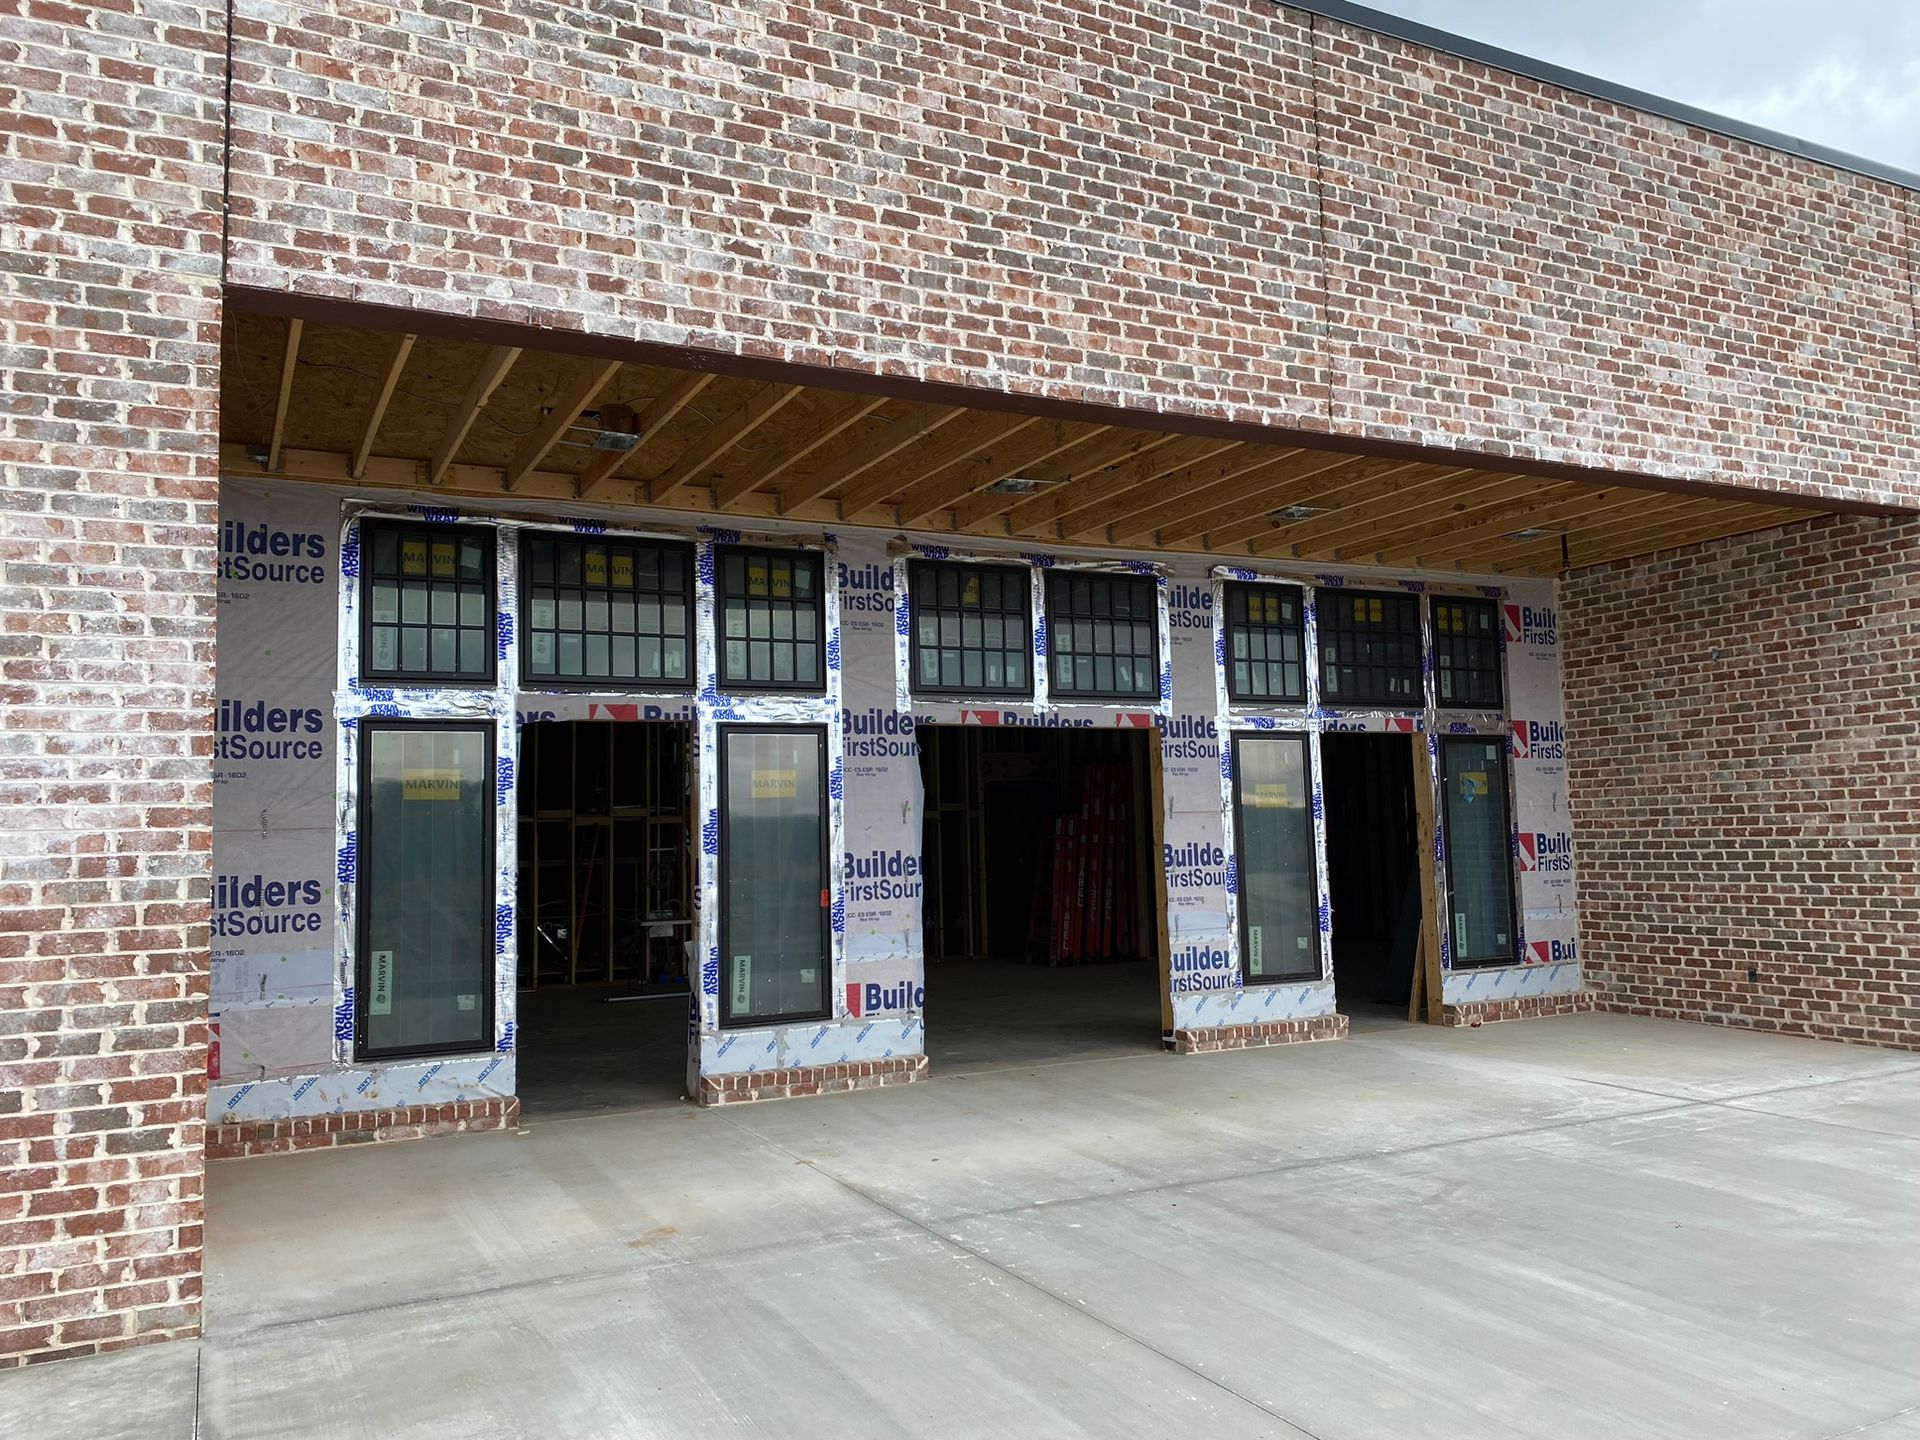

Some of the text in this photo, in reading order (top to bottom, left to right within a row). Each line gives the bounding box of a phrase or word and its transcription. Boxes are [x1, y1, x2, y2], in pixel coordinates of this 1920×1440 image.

[406, 504, 460, 516] WINDOW
[424, 514, 459, 522] WRAP
[558, 516, 607, 529] WINDOW
[218, 521, 325, 558] ilders
[573, 526, 607, 534] WRAP
[697, 525, 741, 537] WINDOW
[713, 535, 741, 544] WRAP
[341, 543, 351, 578] WRAP
[348, 526, 360, 578] WINDOW
[403, 552, 455, 564] MAVIN
[911, 544, 949, 553] WINDOW
[923, 551, 949, 559] WRAP
[1019, 552, 1055, 561] WINDOW
[1032, 559, 1055, 567] WRAP
[586, 564, 633, 576] MAVIN
[705, 544, 714, 585] WINDOW
[1121, 560, 1154, 570] WINDOW
[1228, 568, 1258, 576] WINDOW
[1315, 574, 1344, 582] WINDOW
[750, 577, 790, 587] MAVIN
[505, 613, 514, 645] WRAP
[896, 607, 904, 635] WRAP
[498, 613, 507, 661] WINDOW
[832, 627, 840, 670] WINDOW
[1523, 629, 1557, 645] FirstS
[827, 641, 835, 670] WRAP
[353, 690, 394, 698] WINDOW
[214, 699, 323, 733] ilders
[1530, 743, 1565, 759] FirstS
[405, 779, 459, 790] MARVIN
[497, 757, 506, 806] WINDOW
[504, 757, 514, 791] WRAP
[754, 780, 795, 788] MARVIN
[830, 770, 838, 799] WRAP
[835, 756, 843, 800] WINDOW
[709, 808, 717, 855] WINDOW
[338, 848, 347, 883] WRAP
[346, 831, 356, 883] WINDOW
[1538, 855, 1574, 871] FirstS
[503, 905, 513, 938] WRAP
[832, 901, 840, 932] WRAP
[837, 887, 845, 932] WINDOW
[496, 904, 506, 954] WINDOW
[376, 955, 386, 993] MARVIN
[703, 963, 711, 994] WRAP
[709, 947, 717, 994] WINDOW
[738, 959, 746, 993] MARVIN
[335, 1006, 345, 1041] WRAP
[344, 987, 355, 1041] WINDOW
